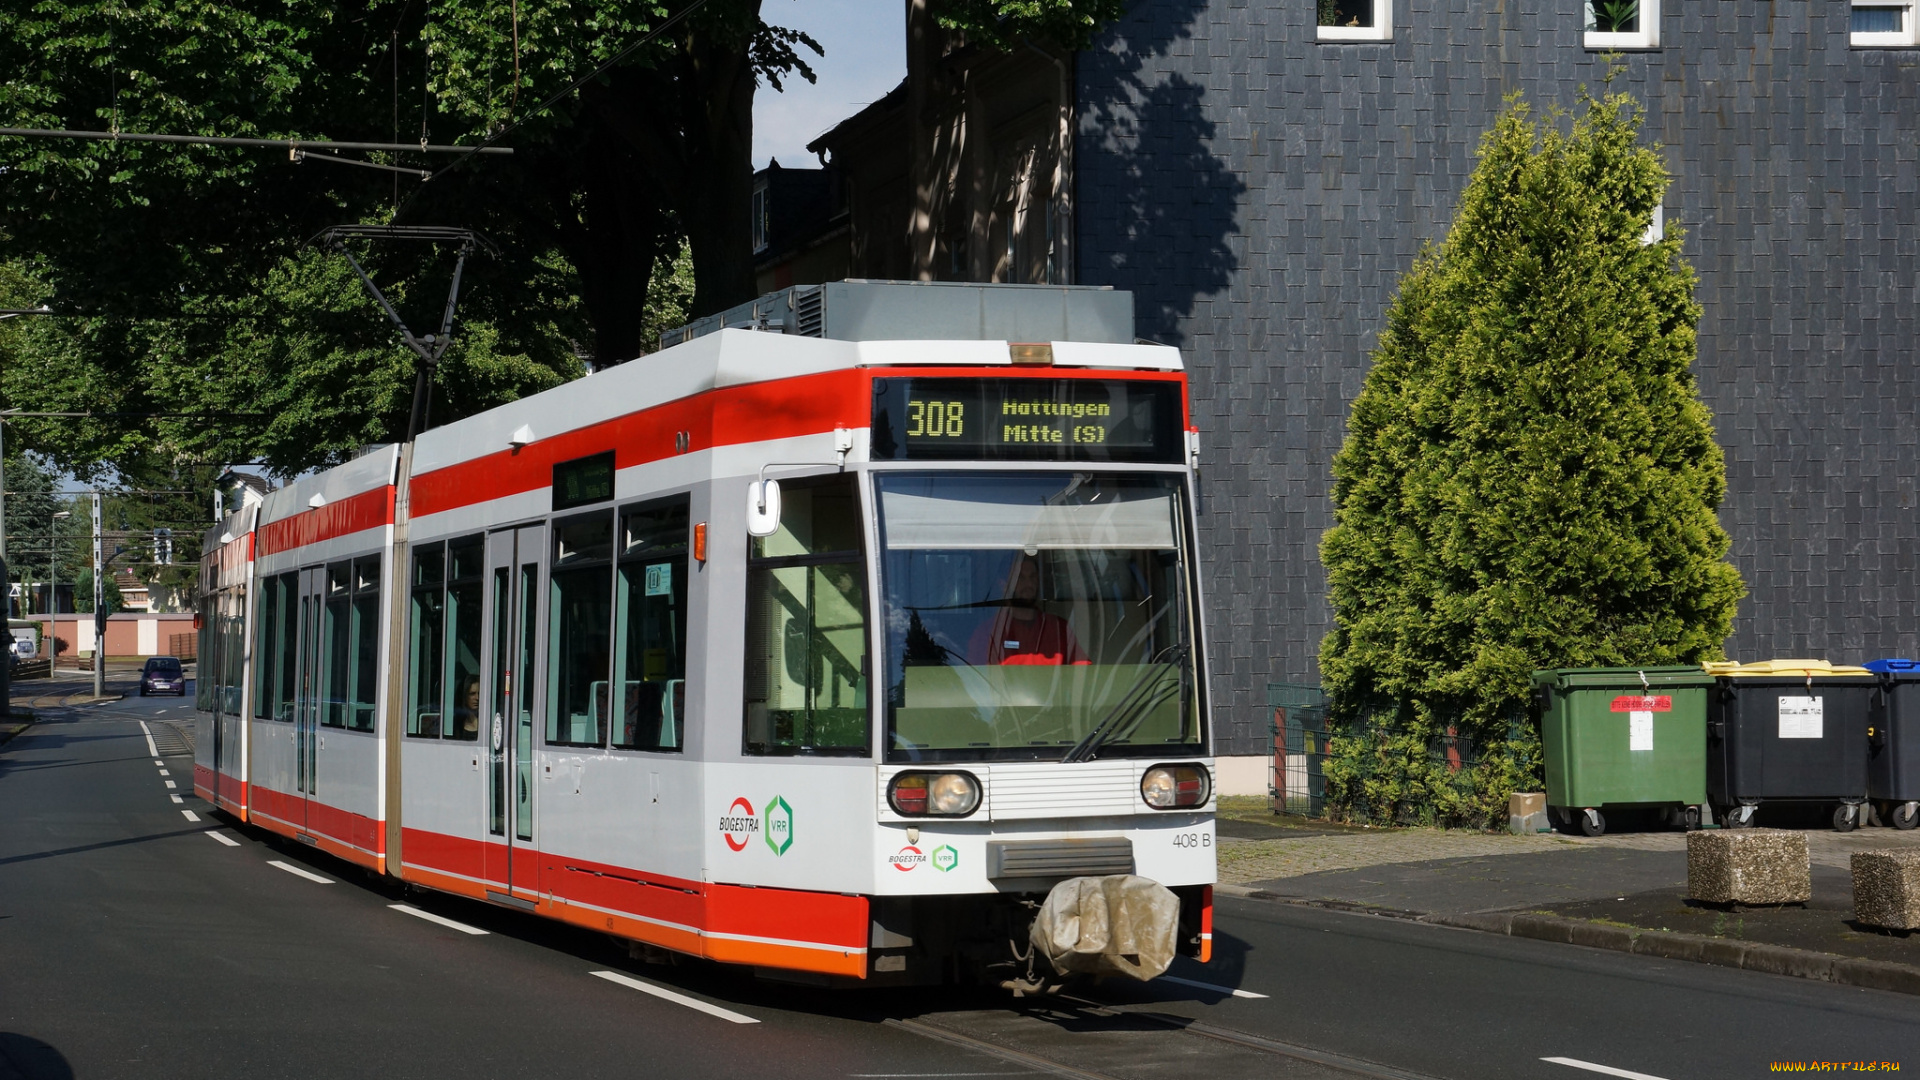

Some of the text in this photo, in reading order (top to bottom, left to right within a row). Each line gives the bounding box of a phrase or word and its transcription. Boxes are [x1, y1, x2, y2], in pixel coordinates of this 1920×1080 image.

[1003, 400, 1110, 418] Hattingen
[907, 401, 964, 437] 308
[1003, 425, 1105, 443] Mitte (S)
[719, 816, 759, 832] BOGESTRA
[770, 819, 788, 833] VRR
[1172, 833, 1212, 848] 408 B
[888, 855, 927, 863] BOGESTRA
